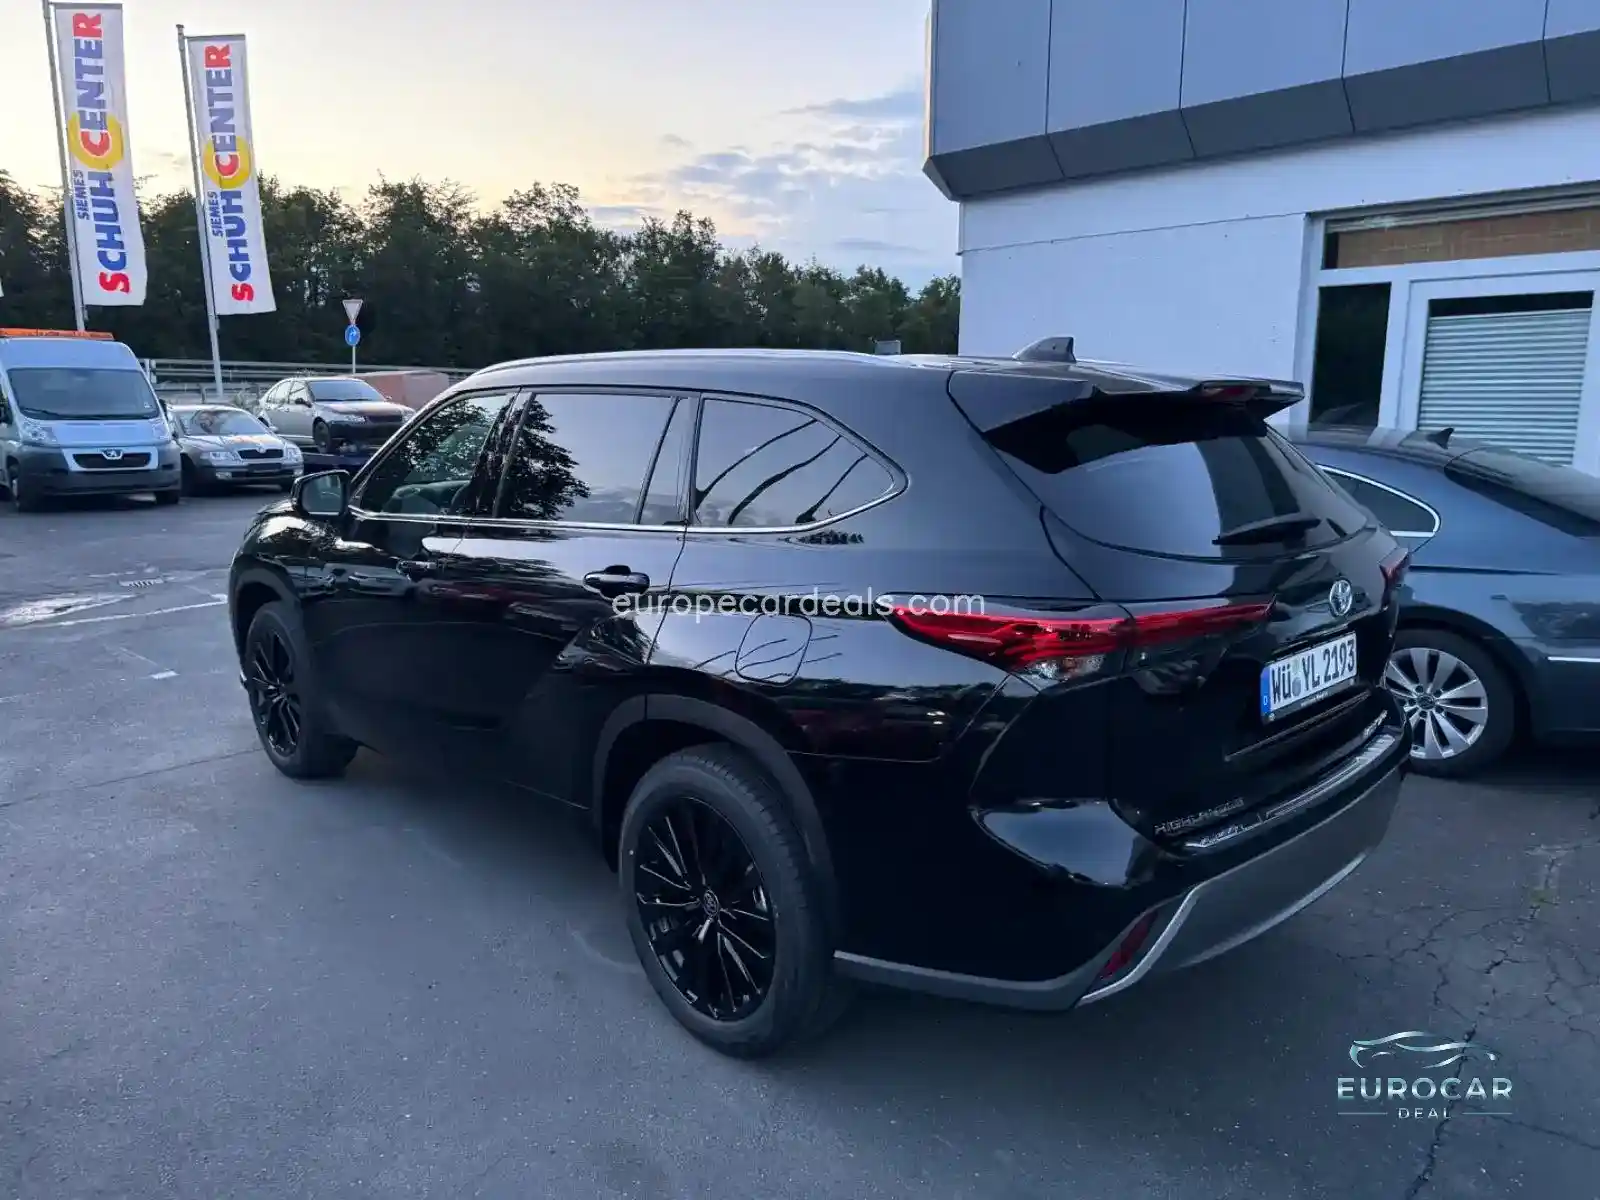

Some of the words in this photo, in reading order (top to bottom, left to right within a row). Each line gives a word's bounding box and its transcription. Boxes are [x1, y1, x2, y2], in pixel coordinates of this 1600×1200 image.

[72, 170, 91, 221] SIEMES
[207, 191, 223, 238] SIEMES
[1302, 653, 1321, 691] YL
[1323, 639, 1355, 683] 2193
